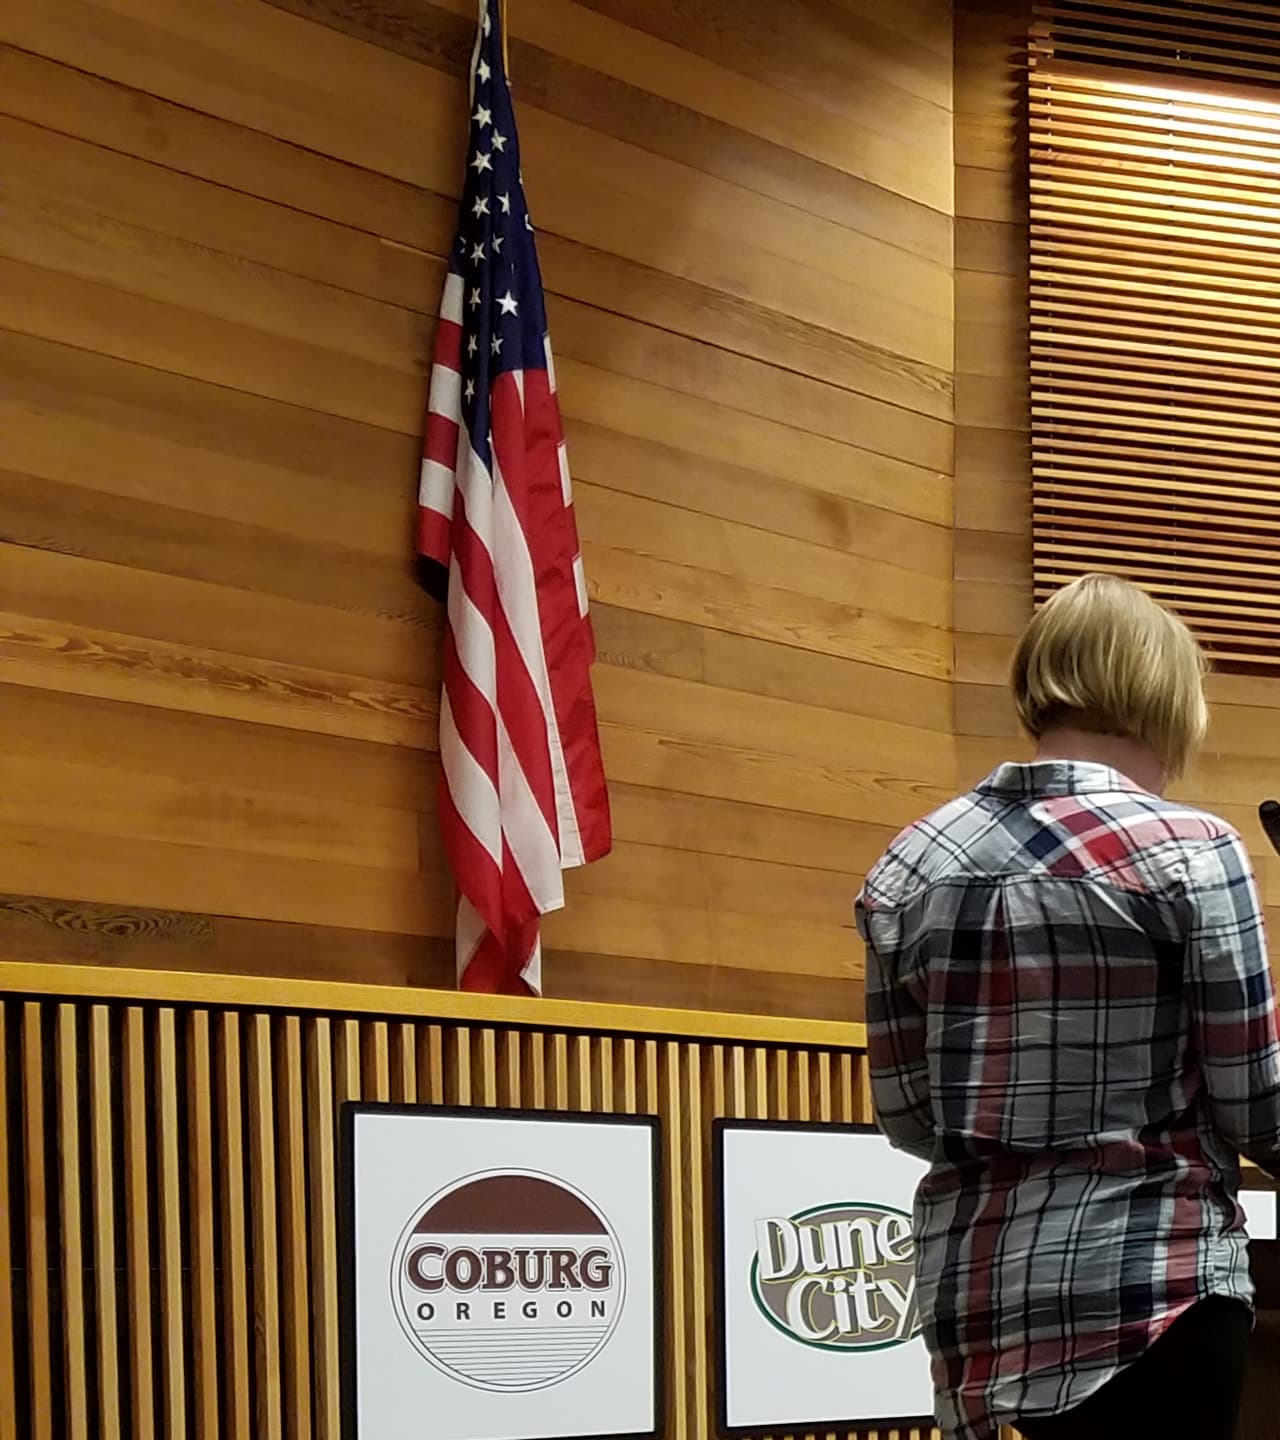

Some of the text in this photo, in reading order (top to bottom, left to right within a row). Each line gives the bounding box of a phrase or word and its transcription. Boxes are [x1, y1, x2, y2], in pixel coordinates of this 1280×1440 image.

[406, 1244, 613, 1292] COBURG
[755, 1216, 915, 1280] Dune
[417, 1300, 605, 1321] OREGON
[786, 1268, 915, 1341] City
